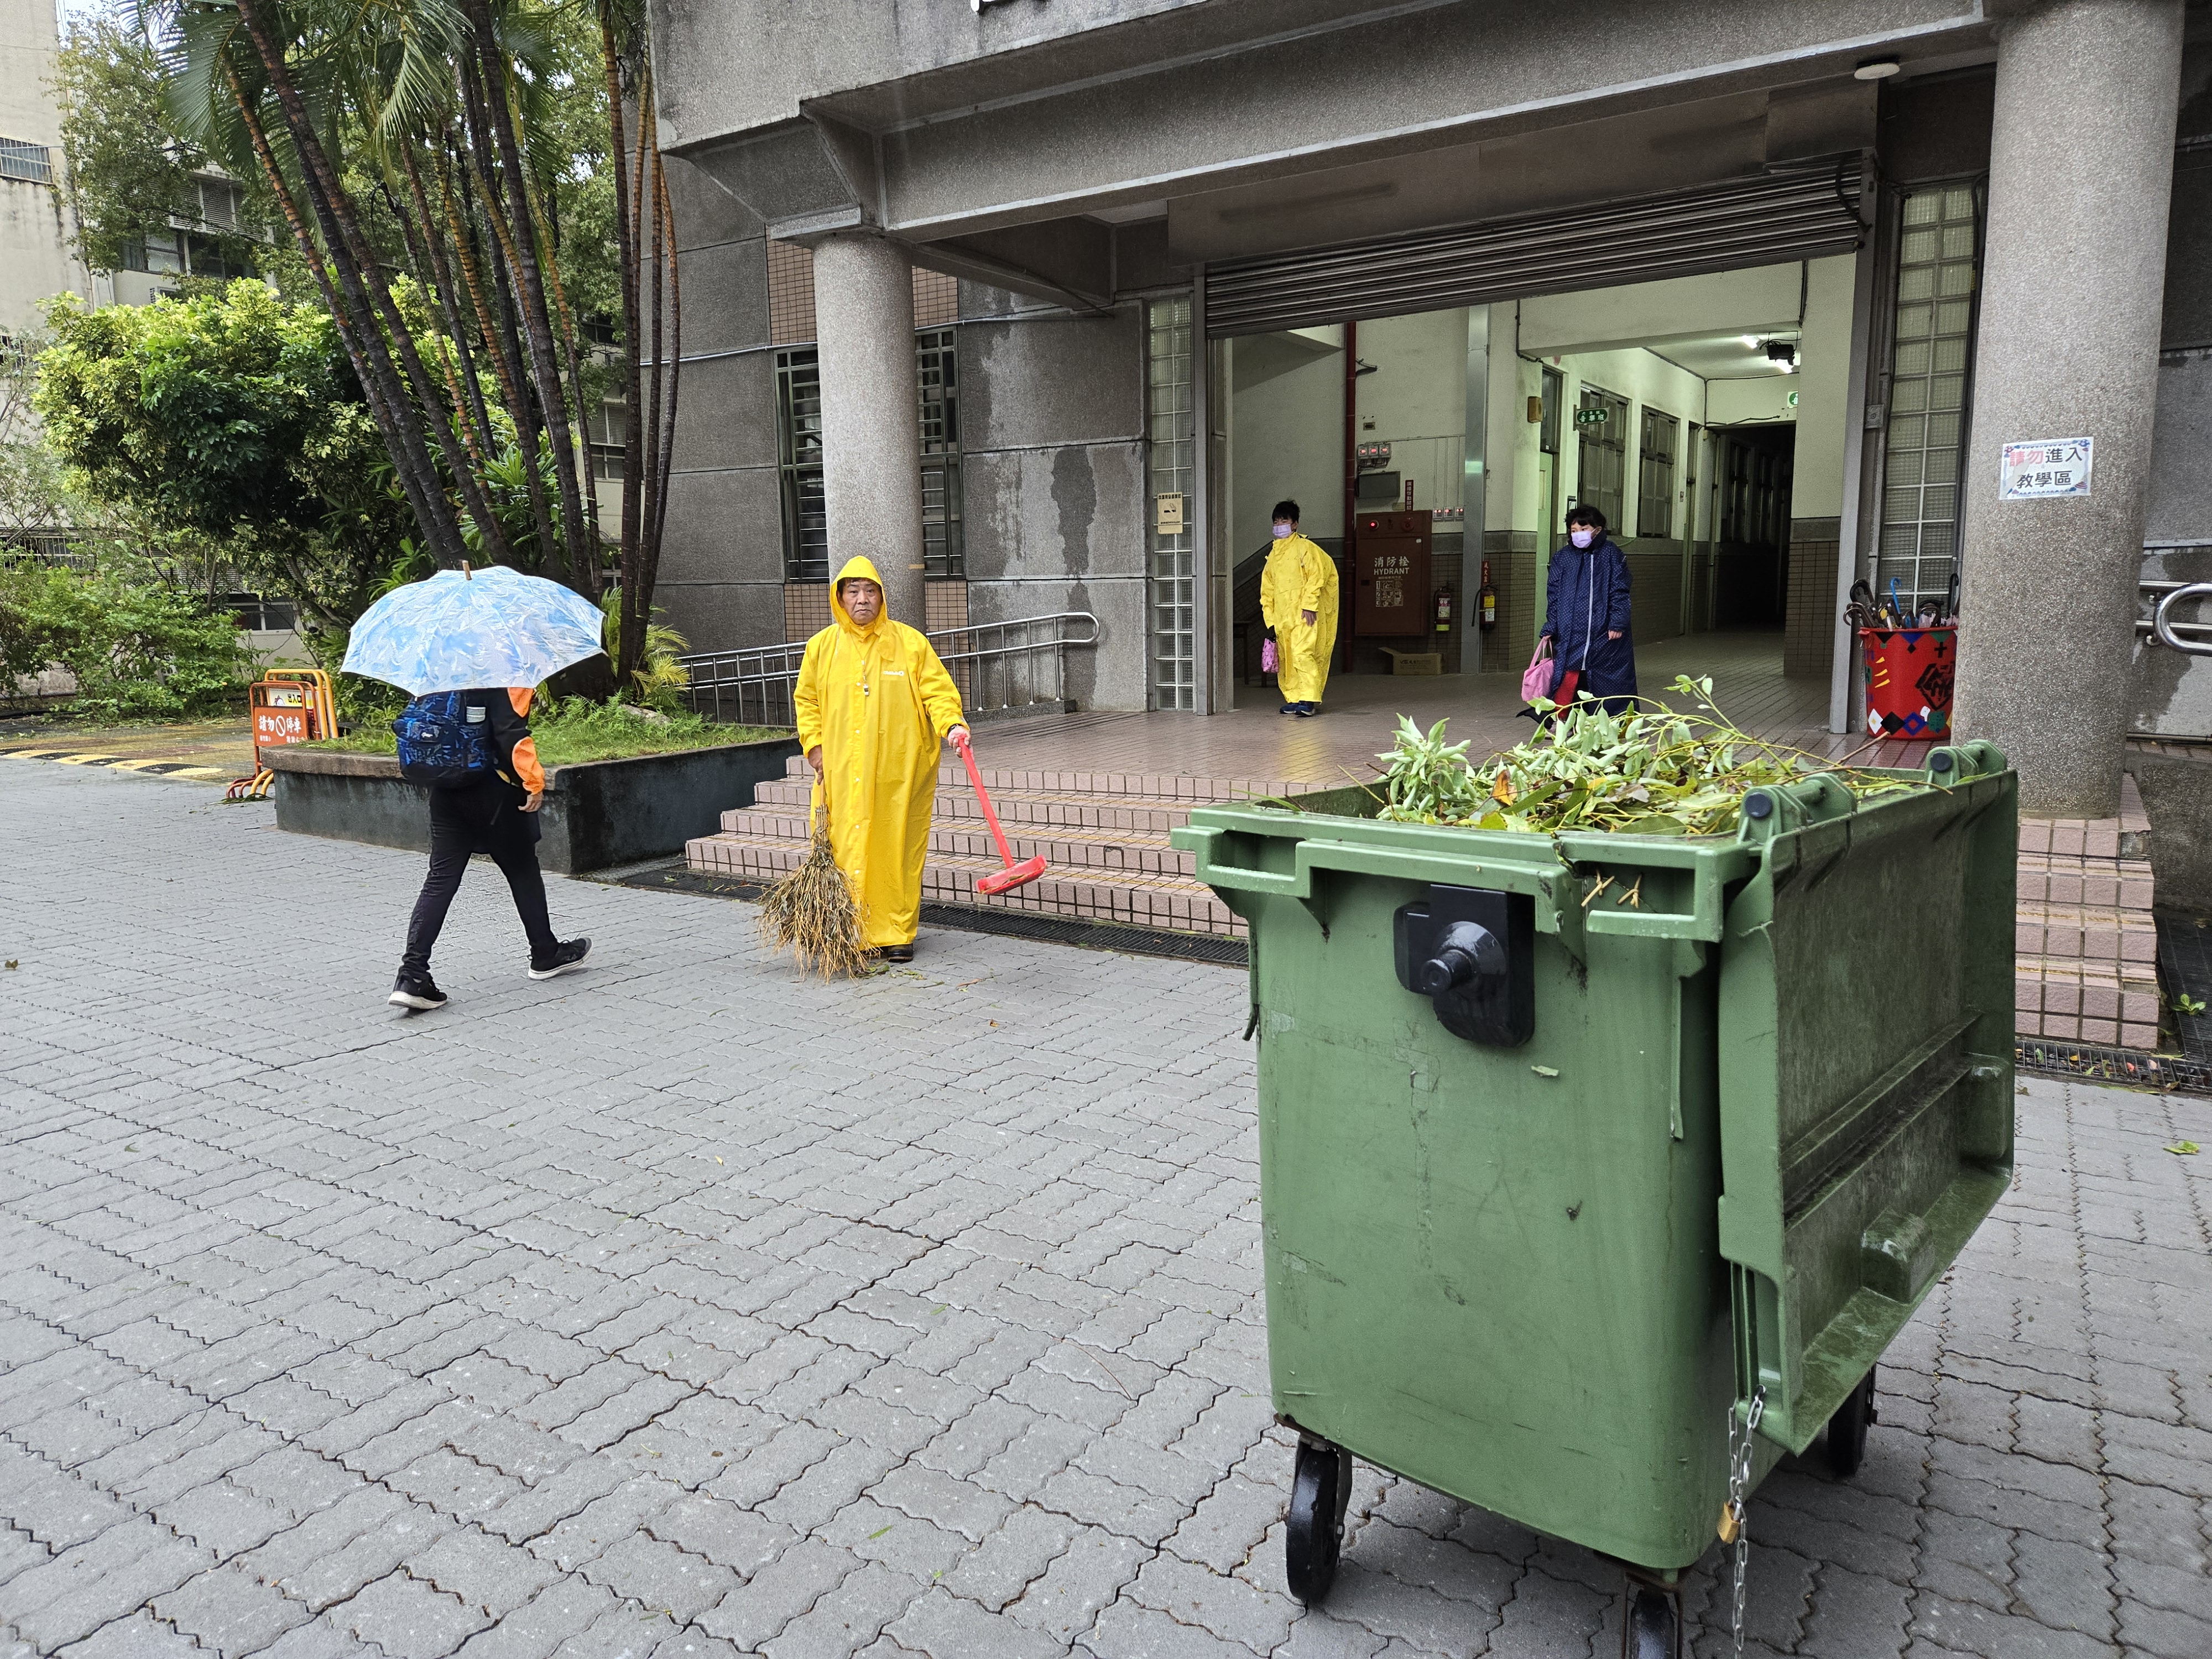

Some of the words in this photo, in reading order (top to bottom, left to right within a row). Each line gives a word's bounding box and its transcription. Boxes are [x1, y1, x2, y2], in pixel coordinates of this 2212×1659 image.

[1579, 414, 1604, 422] 音樂班
[2009, 447, 2083, 467] 請勿進入
[2016, 470, 2073, 489] 教學區
[1374, 556, 1410, 567] 消防栓
[258, 714, 275, 732] 請勿
[286, 716, 301, 734] 停車
